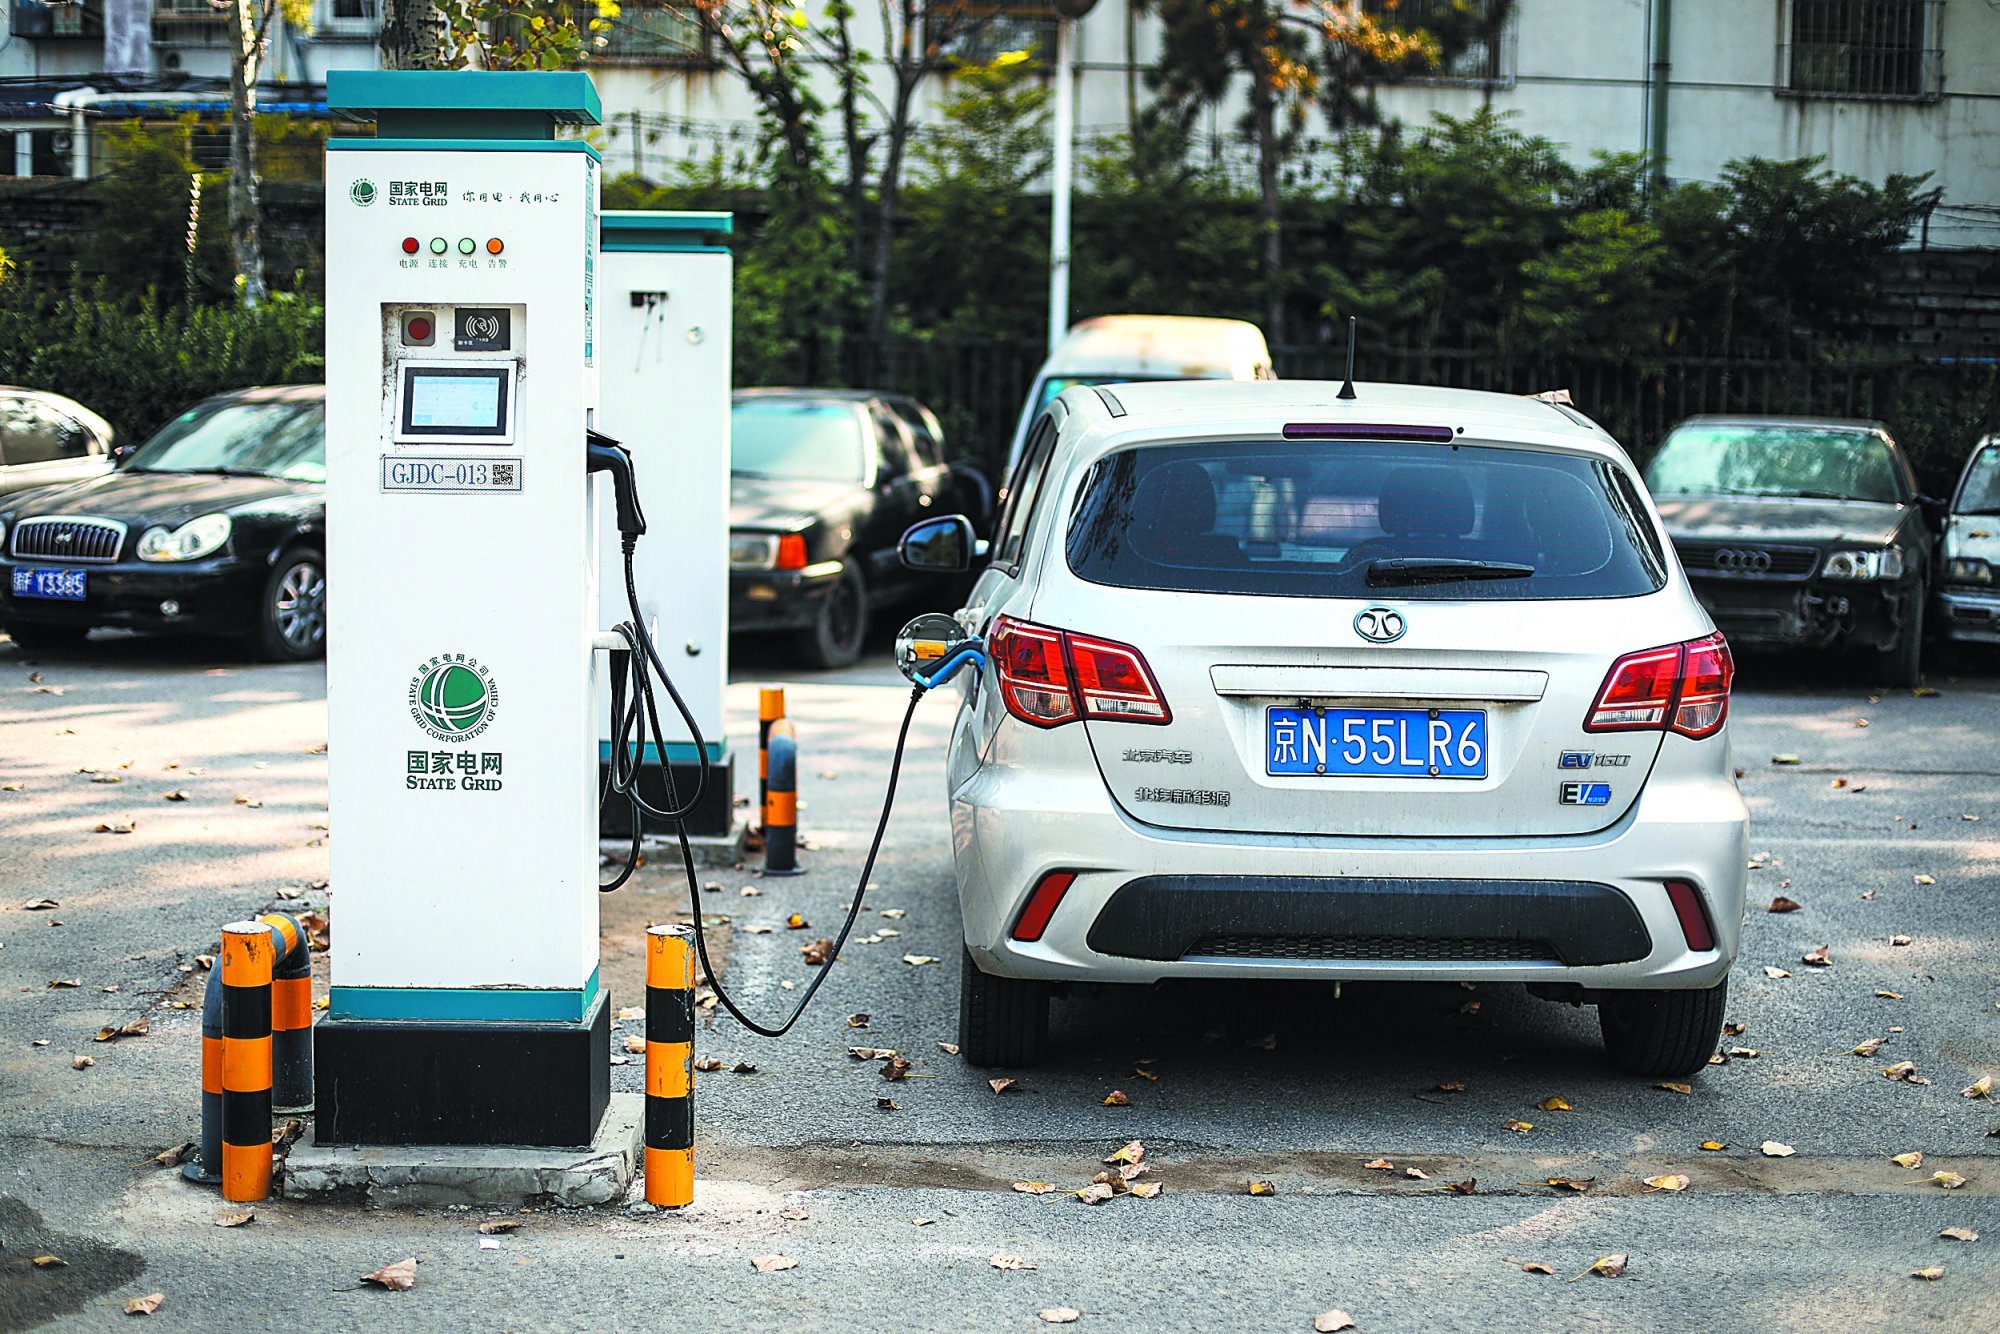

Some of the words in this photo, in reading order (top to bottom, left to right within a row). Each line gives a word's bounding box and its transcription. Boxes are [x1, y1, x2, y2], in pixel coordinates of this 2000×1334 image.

[389, 181, 448, 197] 国家电网
[389, 196, 420, 206] STATE
[422, 196, 448, 206] GRID
[399, 258, 419, 268] 电源
[428, 258, 448, 268] 连接
[458, 259, 478, 268] 充电
[488, 259, 508, 268] 告警
[392, 463, 488, 485] GJDC-013
[418, 653, 489, 676] 国家电网公司
[1273, 717, 1482, 767] 京N·55LR6
[407, 750, 503, 775] 国家电网
[1122, 748, 1193, 764] 北京汽车
[406, 775, 457, 790] STATE
[461, 776, 503, 791] GRID
[1135, 786, 1231, 807] 北汽新能源
